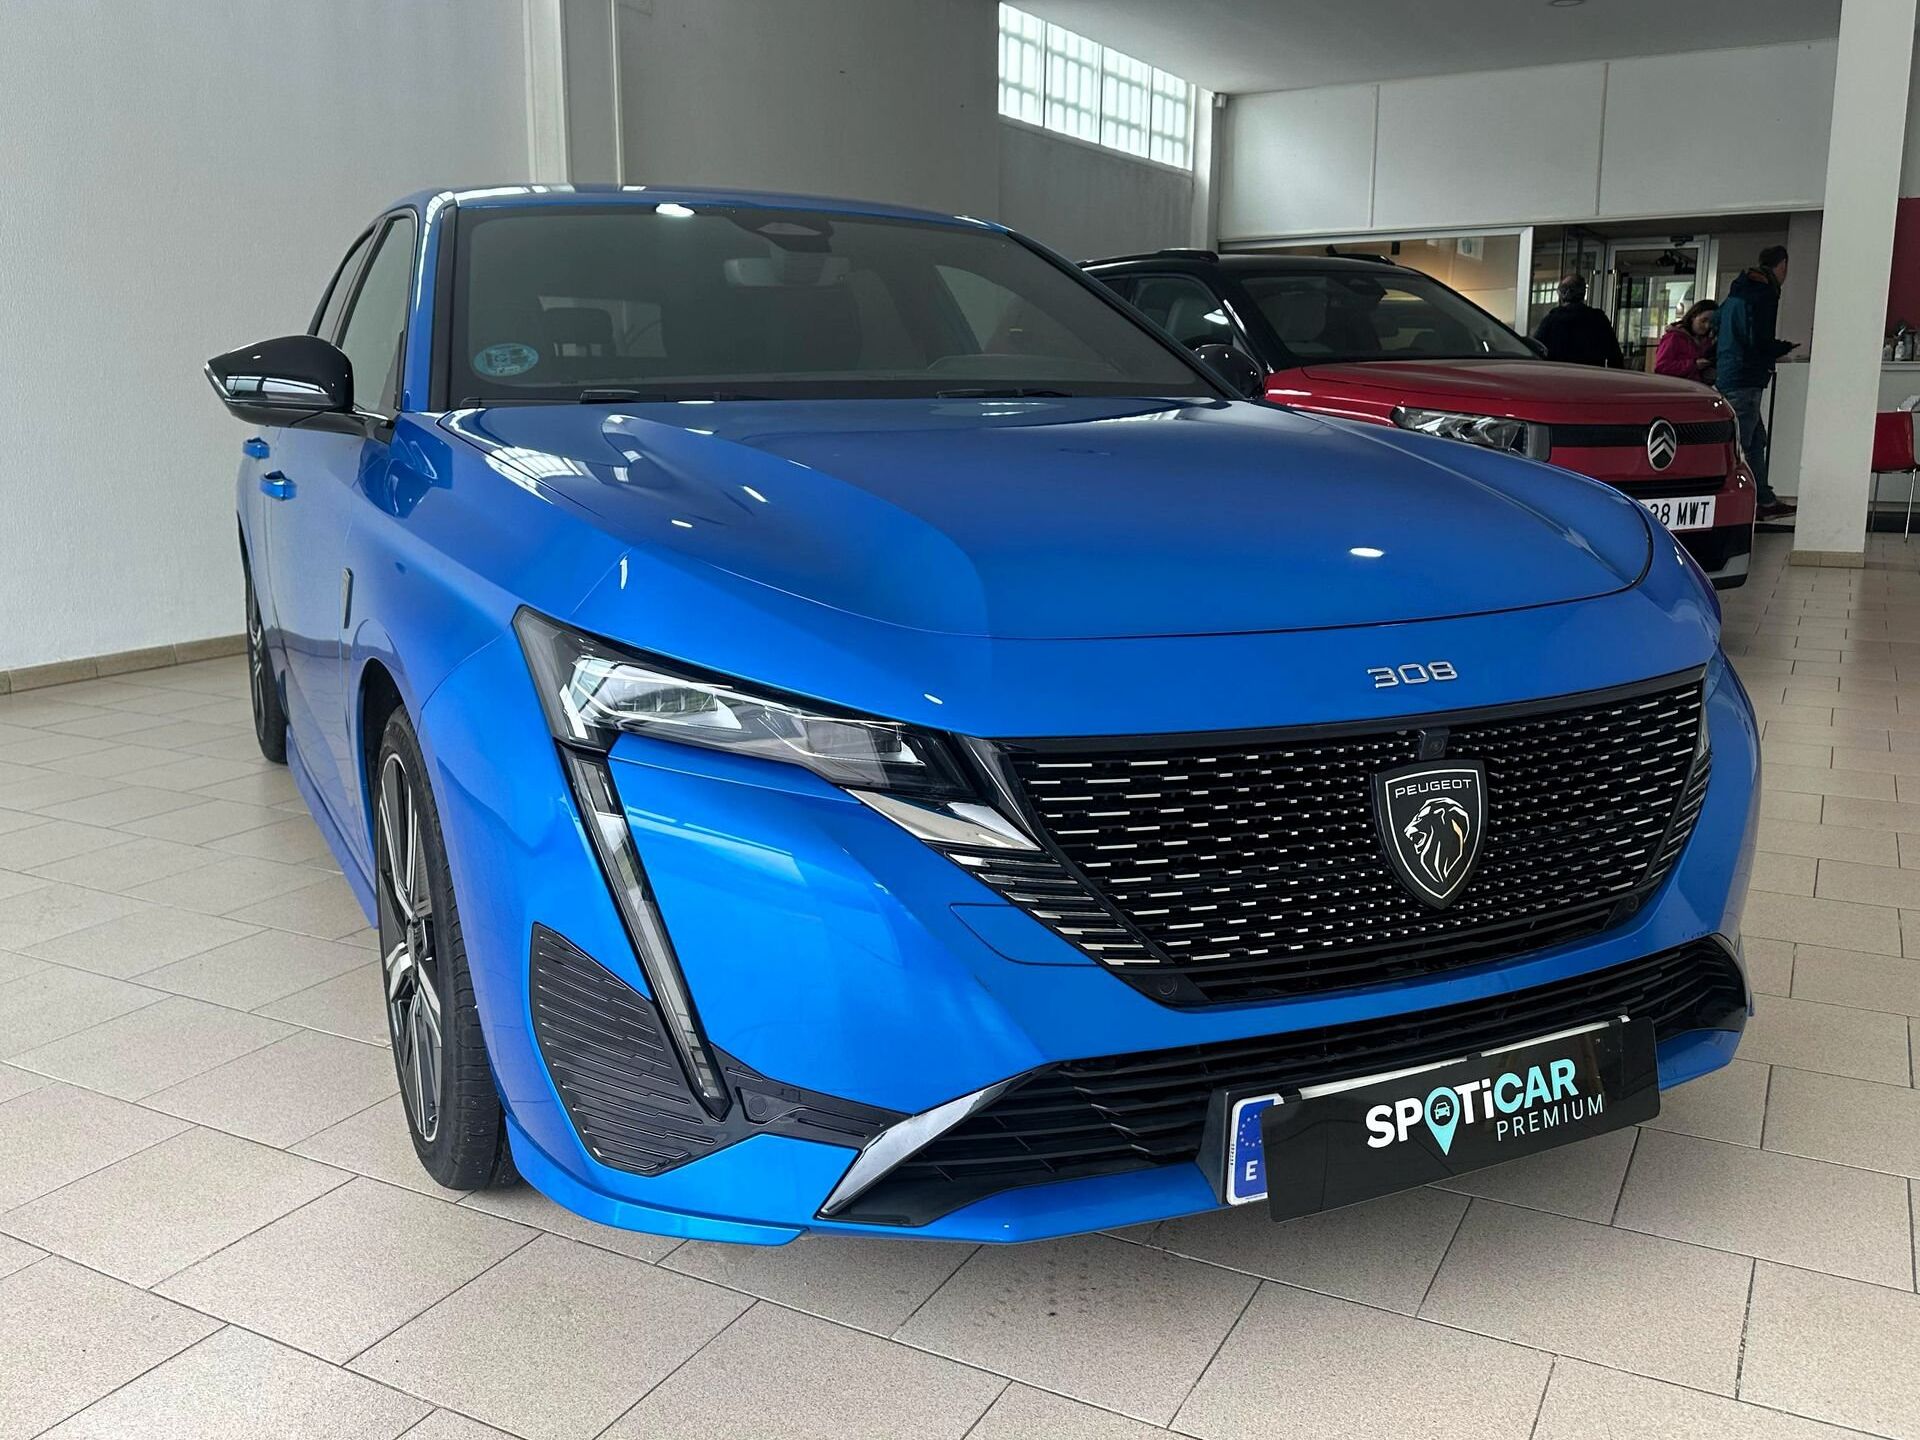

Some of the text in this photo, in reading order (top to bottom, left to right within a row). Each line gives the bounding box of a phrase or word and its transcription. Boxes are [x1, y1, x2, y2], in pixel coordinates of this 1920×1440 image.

[1677, 502, 1710, 526] MWT
[1367, 661, 1458, 689] 308
[1395, 779, 1472, 799] PEUGEOT
[1496, 1093, 1604, 1142] PREMIUM
[1245, 1159, 1259, 1182] E
